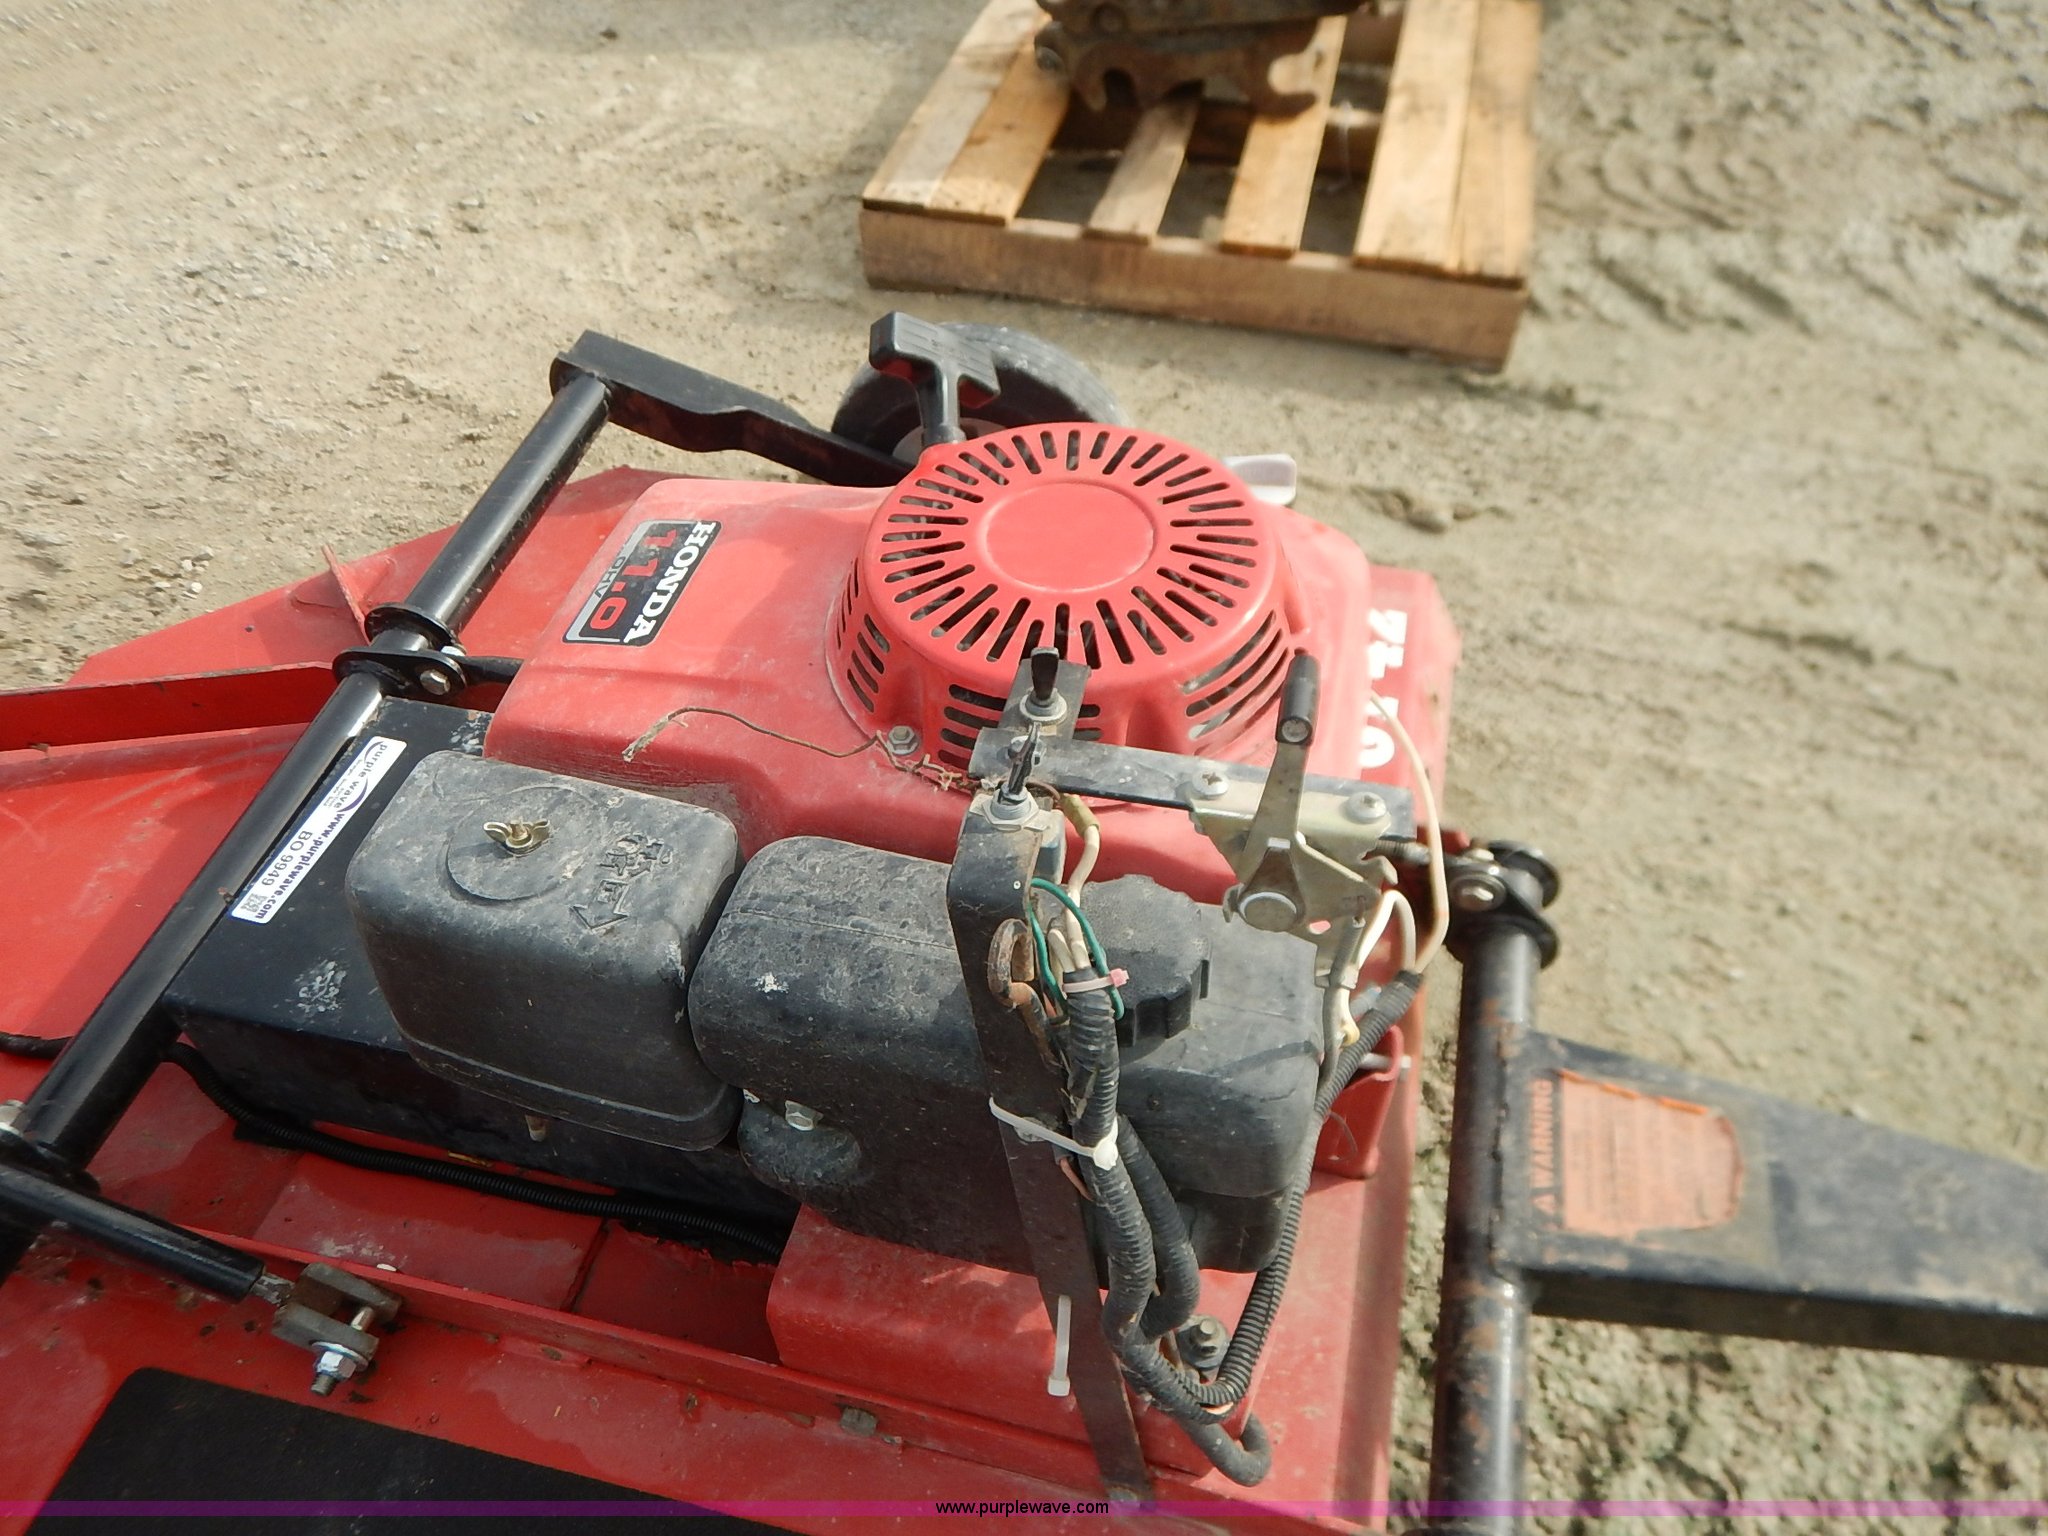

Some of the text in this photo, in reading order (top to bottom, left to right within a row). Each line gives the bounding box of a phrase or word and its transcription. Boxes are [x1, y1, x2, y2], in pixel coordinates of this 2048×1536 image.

[589, 529, 678, 630] 11.0
[594, 556, 627, 598] OHV
[623, 521, 717, 643] HONDA
[358, 744, 388, 778] purple
[333, 780, 360, 809] wave
[255, 813, 345, 920] www.purplewave.com
[261, 854, 294, 886] 9949
